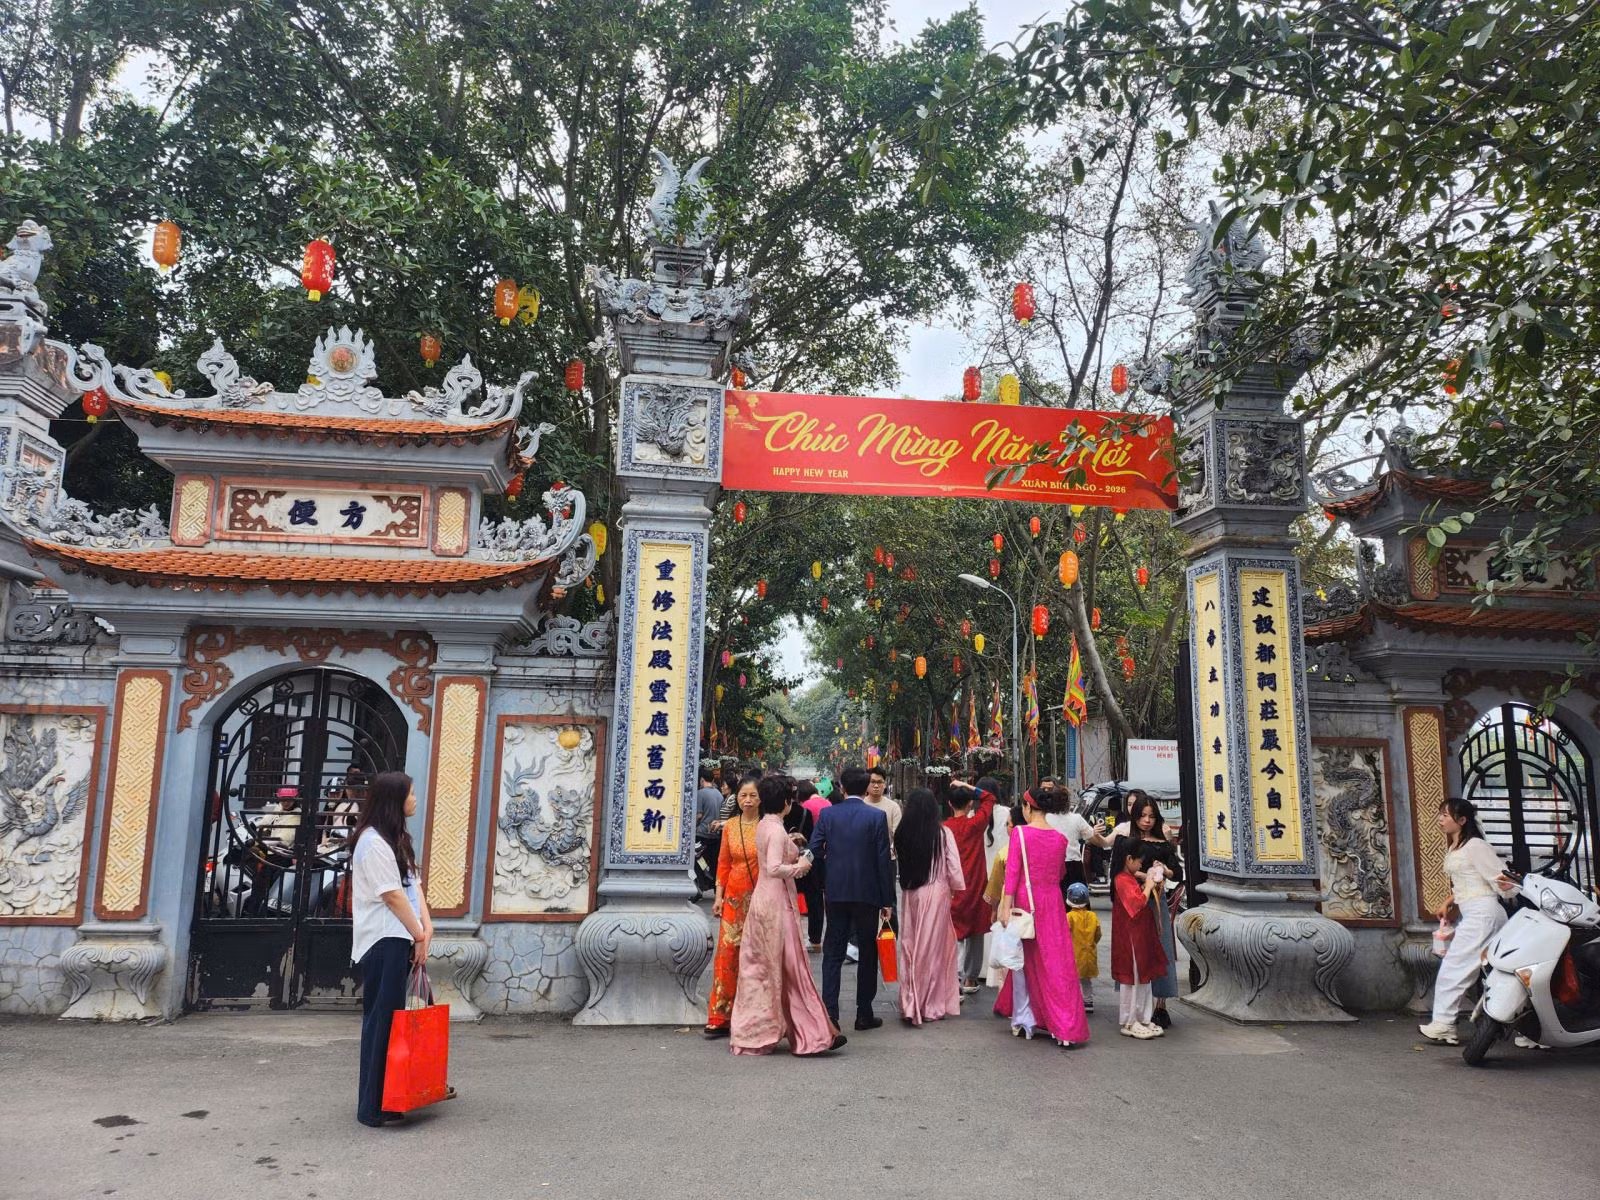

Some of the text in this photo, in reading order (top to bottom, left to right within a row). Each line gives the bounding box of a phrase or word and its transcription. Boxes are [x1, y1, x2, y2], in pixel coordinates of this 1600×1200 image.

[752, 411, 849, 452] Chúc
[858, 413, 964, 477] Mừng
[773, 466, 848, 479] HAPPY NEW YEAR
[1021, 478, 1048, 489] XUÂN
[1049, 480, 1075, 491] BÍN
[1105, 485, 1126, 494] 2026
